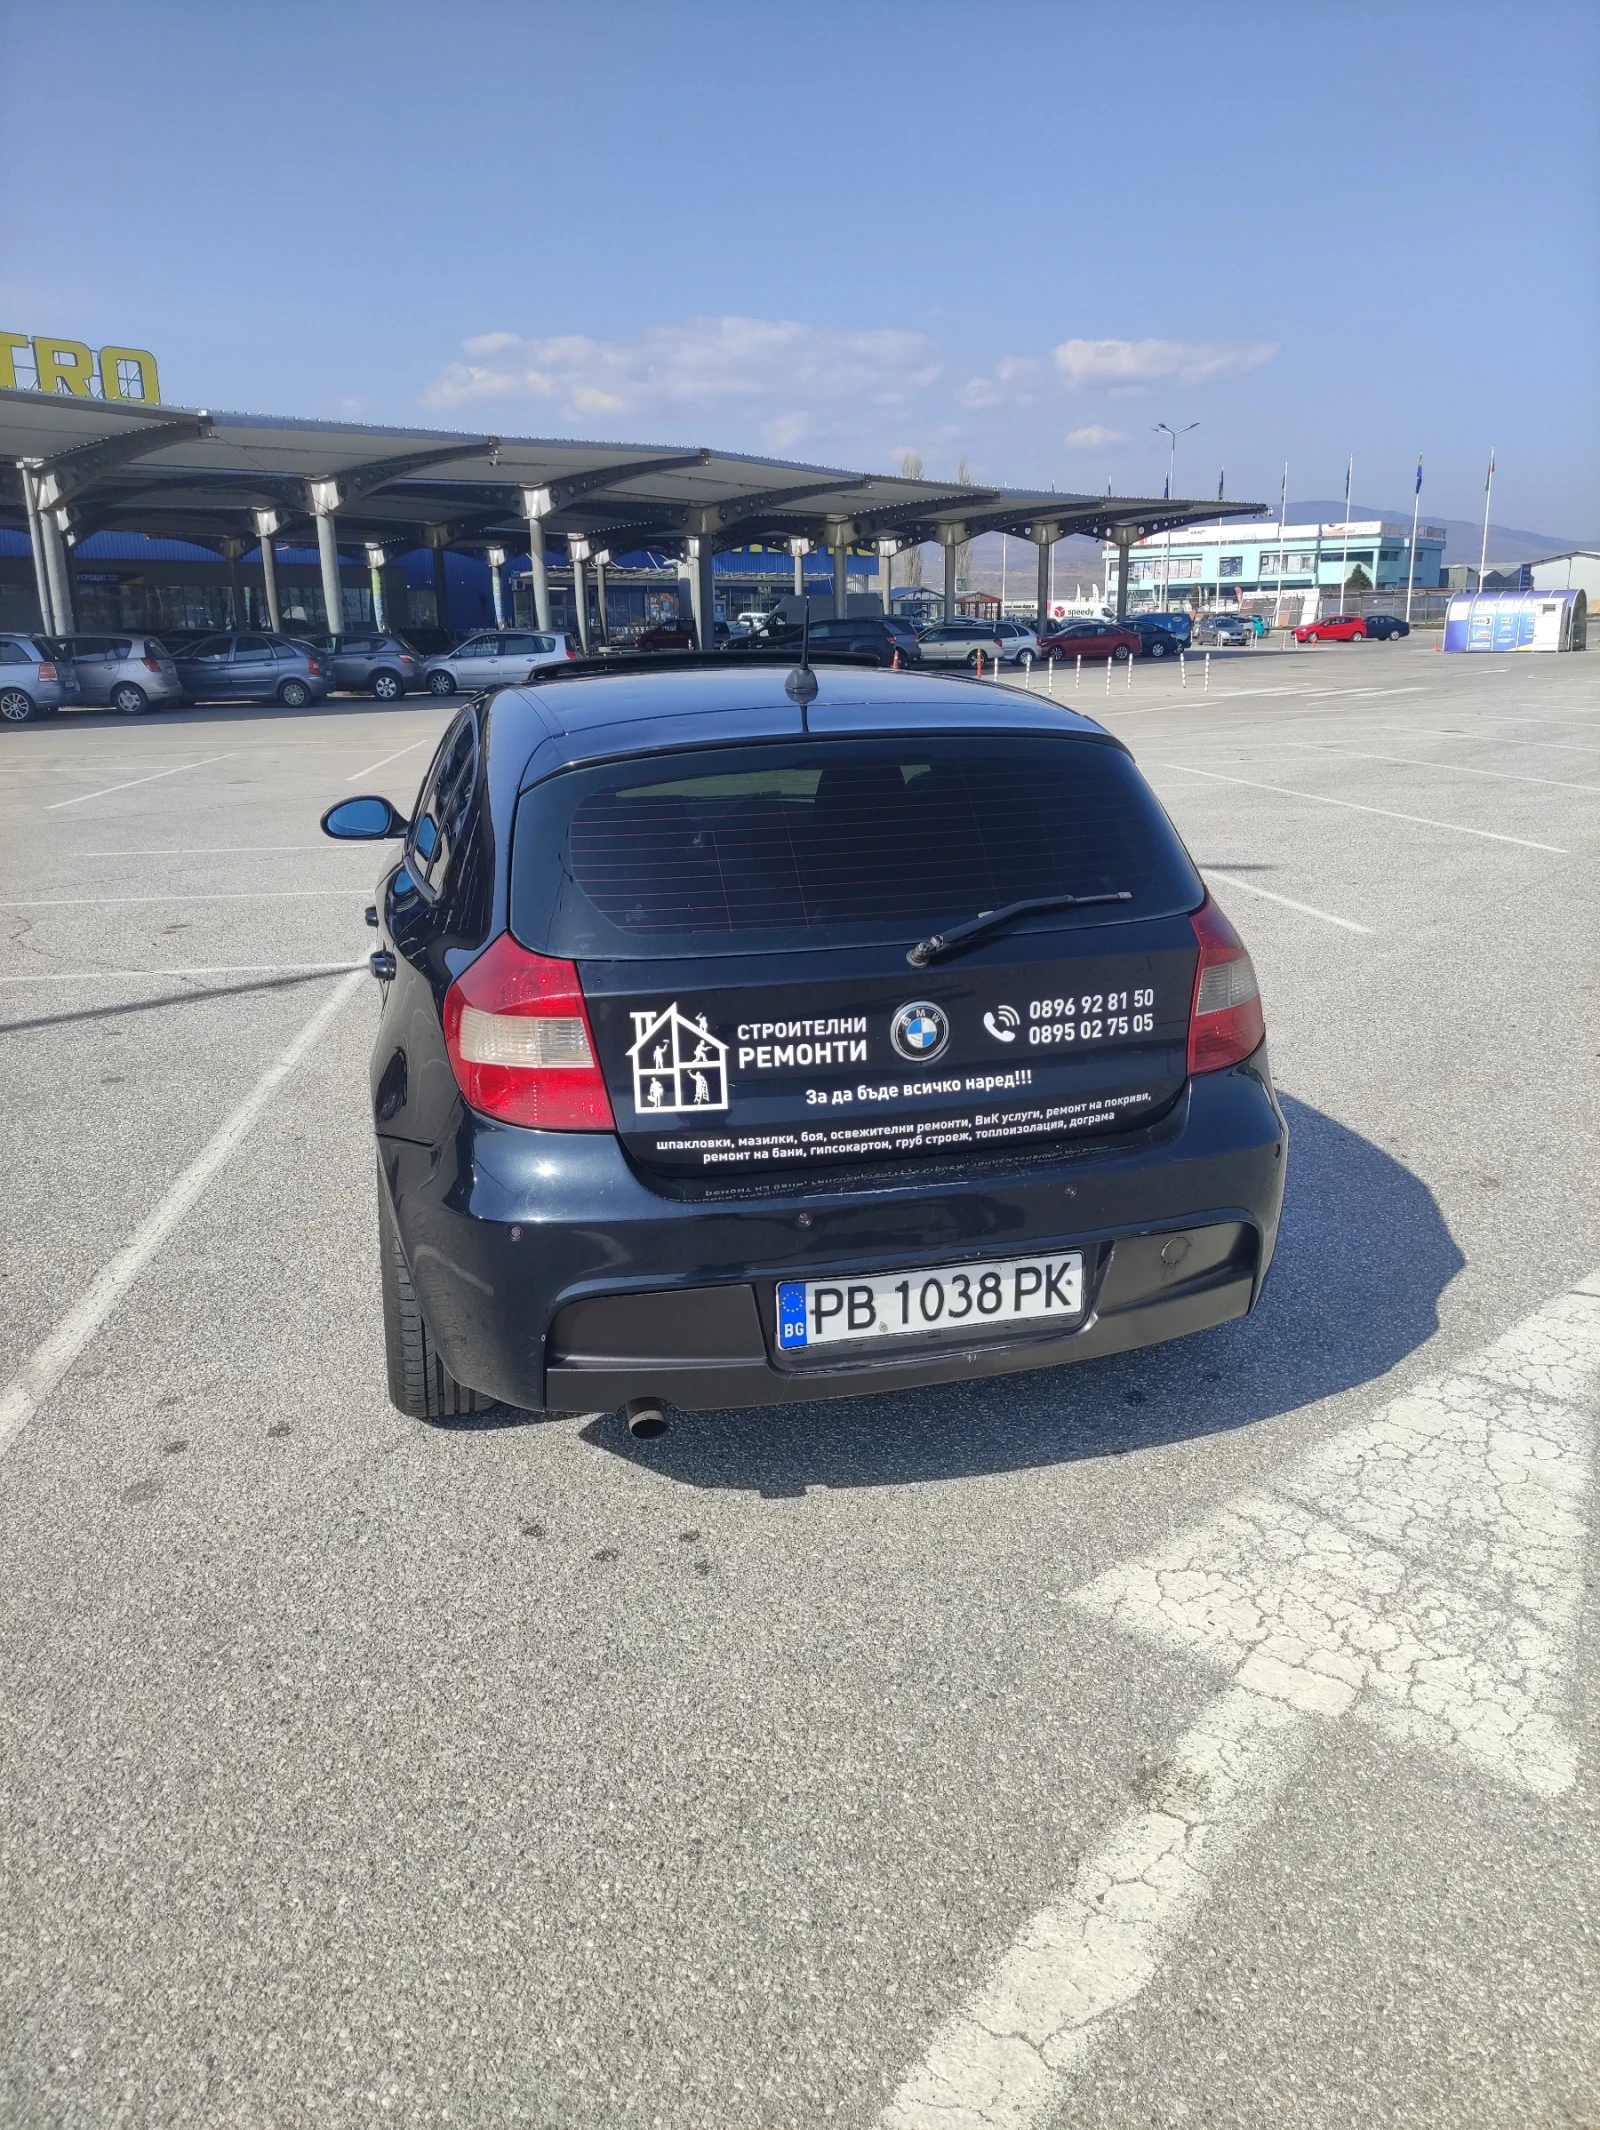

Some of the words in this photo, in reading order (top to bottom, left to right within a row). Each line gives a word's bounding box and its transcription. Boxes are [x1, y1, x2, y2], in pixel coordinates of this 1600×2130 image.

[1067, 607, 1095, 618] speedy
[1029, 998, 1076, 1020] 0896
[1081, 994, 1103, 1014] 92
[1107, 991, 1127, 1011] 81
[1133, 988, 1154, 1008] 50
[737, 1016, 867, 1041] СТРОИТЕЛНИ
[1028, 1022, 1076, 1045] 0895
[1080, 1019, 1103, 1039] 02
[1106, 1016, 1129, 1036] 75
[1132, 1012, 1154, 1032] 05
[738, 1040, 867, 1070] РЕМОНТИ
[805, 1089, 829, 1105] За
[831, 1089, 853, 1106] да
[856, 1084, 899, 1103] бъде
[903, 1079, 962, 1098] всичко
[965, 1069, 1033, 1093] наред!!!
[656, 1138, 736, 1151] шпакловки,
[738, 1134, 799, 1149] мазилки,
[800, 1130, 829, 1144] боя,
[830, 1124, 914, 1141] освежителни
[915, 1118, 973, 1135] ремонти,
[974, 1112, 1000, 1127] ВиК
[1001, 1109, 1044, 1126] услуги,
[1046, 1103, 1088, 1121] ремонт
[1089, 1100, 1103, 1111] на
[1104, 1092, 1153, 1110] покриви,
[703, 1151, 752, 1166] ремонт
[753, 1149, 770, 1161] на
[771, 1147, 808, 1159] бани,
[810, 1140, 894, 1158] гипсокартон,
[895, 1134, 924, 1151] груб
[925, 1131, 974, 1147] строеж,
[974, 1119, 1069, 1140] топлоизолация,
[1069, 1112, 1116, 1130] дограма
[814, 1286, 876, 1335] PB
[895, 1272, 1002, 1325] 1038
[1014, 1261, 1072, 1312] PK
[783, 1321, 805, 1338] BG
